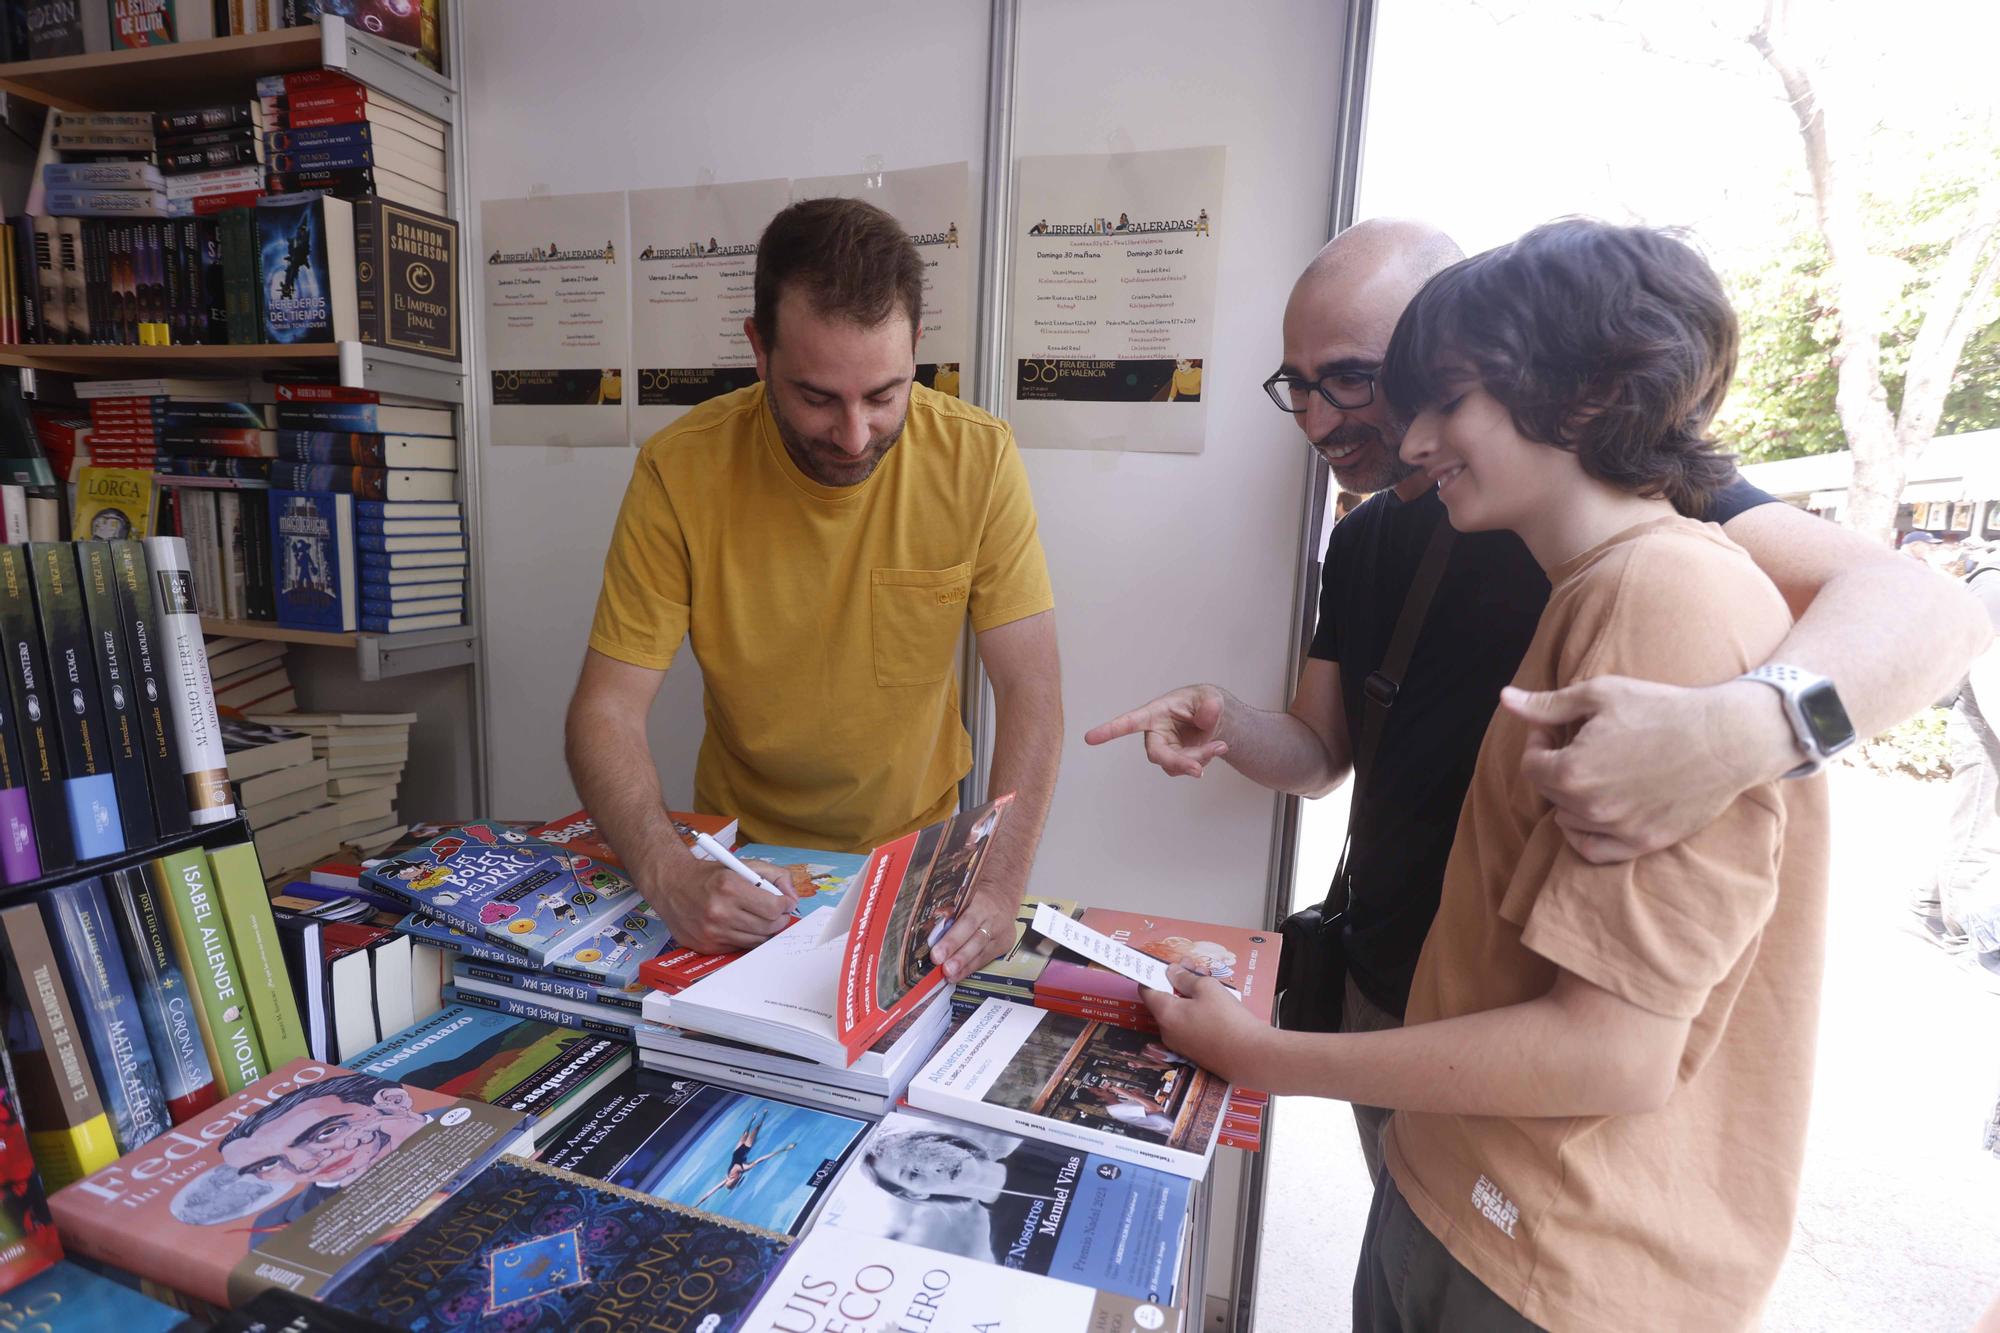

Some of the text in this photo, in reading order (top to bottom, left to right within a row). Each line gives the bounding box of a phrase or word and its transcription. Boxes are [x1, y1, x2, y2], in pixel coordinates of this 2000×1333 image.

[122, 12, 164, 35] DE LILITH
[396, 222, 442, 246] BRANDON
[1045, 220, 1194, 235] LIBRERÍA GALERADAS
[391, 236, 448, 263] SANDERSON
[500, 249, 604, 261] LIBRERÍA GALERADAS
[652, 244, 760, 259] LIBRERÍA GALERAD
[1037, 252, 1062, 260] Domingo
[1126, 250, 1152, 258] Domingo
[1164, 248, 1184, 256] tarde
[269, 296, 326, 310] HEREDEROS
[270, 309, 326, 322] DEL TIEMPO
[394, 293, 447, 317] EL IMPERIO
[407, 312, 436, 330] FINAL
[495, 368, 520, 391] 58
[642, 368, 670, 391] 58
[696, 369, 716, 377] LLIBRE
[1023, 359, 1058, 383] 58
[88, 479, 141, 498] LORCA
[49, 549, 64, 597] ALFAGUARA
[90, 551, 106, 595] ALFAGUARA
[935, 586, 967, 606] Levi's
[104, 631, 120, 680] DE LA CRUZ
[136, 620, 152, 673] DEL MOLINO
[18, 642, 36, 689] MONTERO
[66, 648, 80, 684] ATXAGA
[177, 634, 208, 746] MÁXIMO HUERTA
[120, 715, 130, 746] herederas
[152, 708, 168, 758] Un González
[444, 852, 508, 888] BOLES
[456, 853, 477, 870] LES
[461, 882, 486, 898] DEL
[485, 854, 535, 886] DRAC
[183, 864, 234, 1000] ISABEL ALLENDE
[419, 902, 478, 934] LES BOLES DEL DRAC
[145, 914, 168, 968] LUIS CORRAL
[471, 946, 490, 959] DRAC
[490, 950, 506, 962] DEL
[844, 942, 862, 1032] Esmorzars
[856, 854, 889, 941] valencians
[509, 954, 529, 968] BOLES
[682, 955, 726, 975] VICENT MARCO
[522, 976, 588, 1000] LES BOLES DEL DRAC
[864, 953, 874, 1016] VICENT MARCO
[168, 997, 192, 1057] CORONA
[404, 1006, 464, 1040] Lorenzo
[508, 1000, 572, 1025] LES BOLES DEL DRAC
[34, 964, 88, 1102] EL HOMBRE DE NEANDERTAL
[362, 1016, 474, 1074] Tostonazo
[928, 1043, 969, 1084] Almuerzos
[965, 1004, 1002, 1042] valencianos
[952, 1068, 960, 1081] LIBRO
[970, 1030, 993, 1056] PROFESIONALES
[998, 1008, 1013, 1024] ALMUERZO
[110, 1020, 154, 1128] MATAR AL REY
[230, 1027, 260, 1086] VIOLET
[523, 1039, 612, 1109] asquerosos
[517, 1059, 562, 1094] NOVELA DEL
[76, 1062, 327, 1205] Federico
[567, 1094, 626, 1148] Araújo Gámir
[581, 1145, 594, 1155] A
[590, 1124, 616, 1146] ESA
[611, 1093, 650, 1124] CHICA
[162, 1160, 208, 1185] Ros
[1472, 1174, 1489, 1197] HEY!
[1038, 1156, 1080, 1237] Manuel Vilas
[1481, 1190, 1517, 1227] READY
[1486, 1182, 1520, 1219] I'LL BE
[1009, 1200, 1045, 1258] Nosotros
[1472, 1193, 1516, 1240] TO CHILL
[379, 1186, 537, 1314] STADLER
[388, 1201, 487, 1282] JULIANE
[1072, 1242, 1091, 1272] Premio
[1084, 1212, 1101, 1242] Nadal
[254, 1264, 304, 1291] Lumen
[576, 1229, 694, 1333] ORONA
[650, 1274, 682, 1308] LOS
[650, 1256, 735, 1333] ELOS
